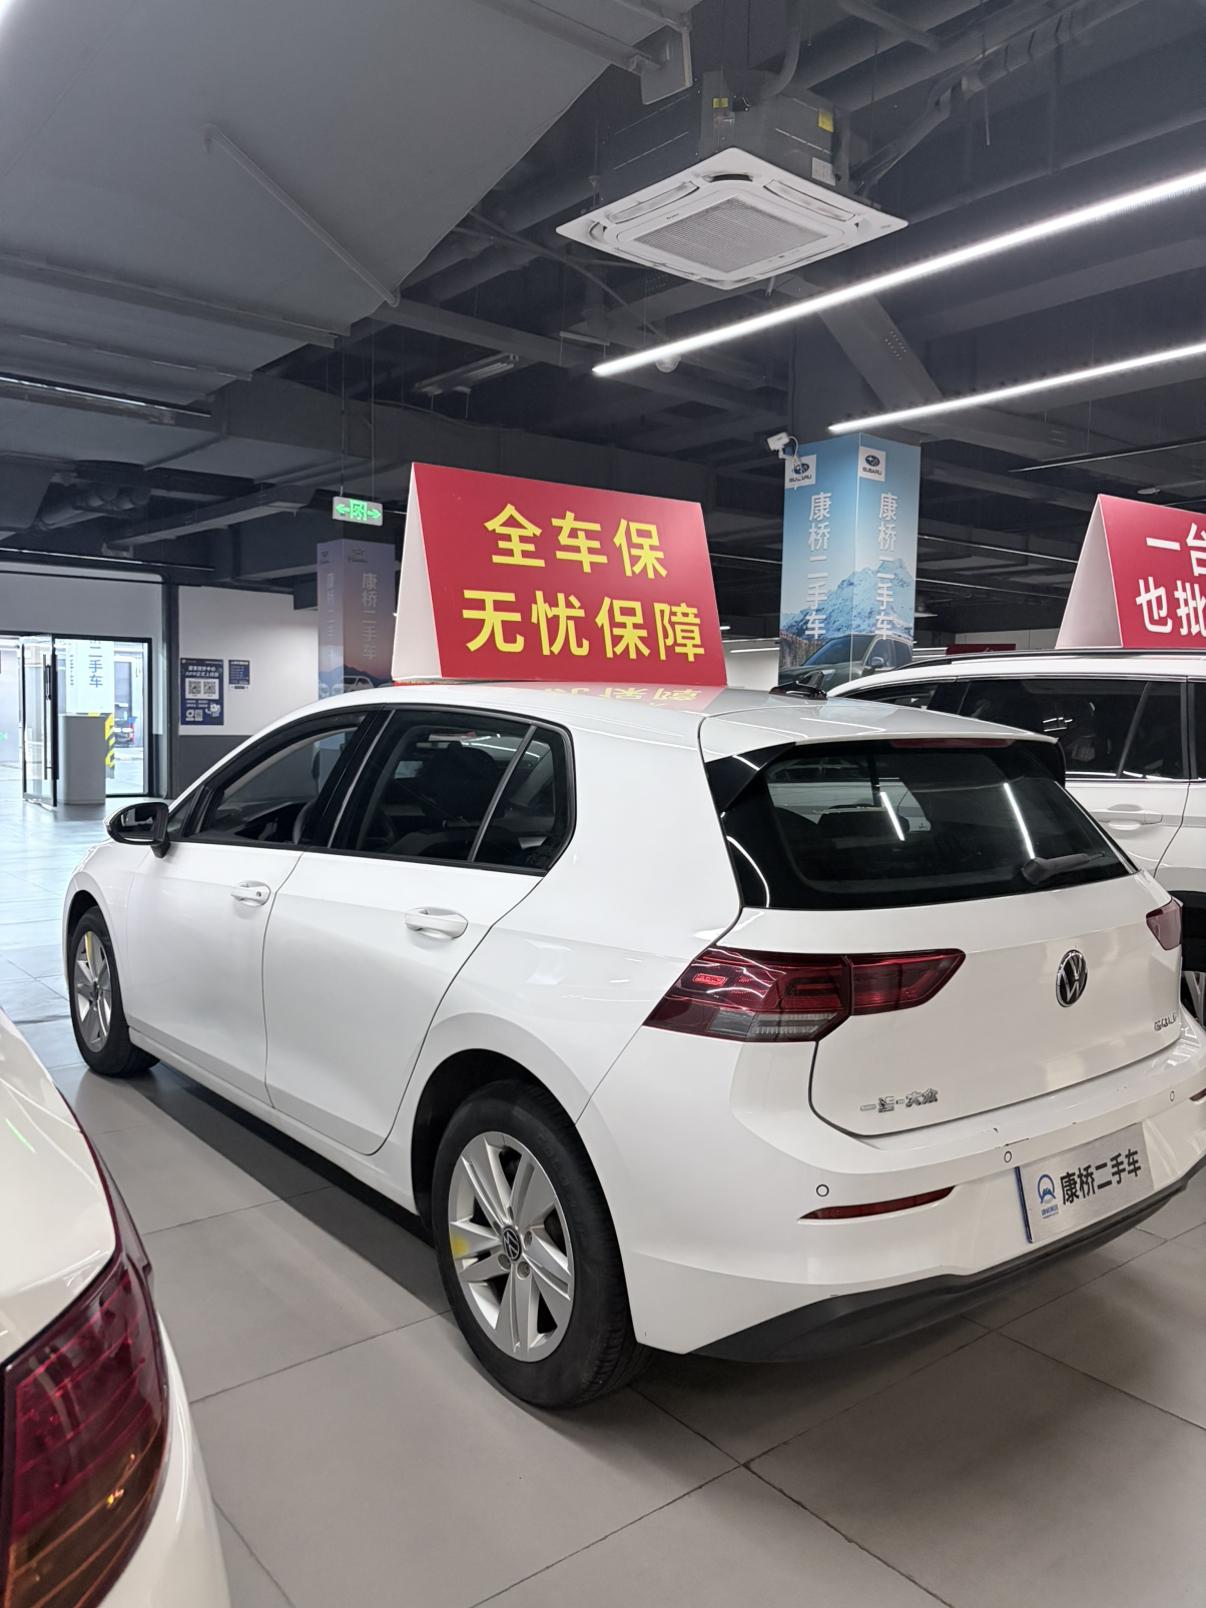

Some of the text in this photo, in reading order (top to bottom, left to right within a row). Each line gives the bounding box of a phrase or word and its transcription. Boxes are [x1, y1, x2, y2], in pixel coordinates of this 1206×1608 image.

[484, 503, 669, 579] 全车保
[805, 491, 832, 640] 康桥二手车
[875, 491, 898, 641] 康桥二手车
[462, 589, 705, 662] 无忧保障
[88, 640, 103, 689] 二手车
[1060, 1148, 1142, 1205] 康桥二手车
